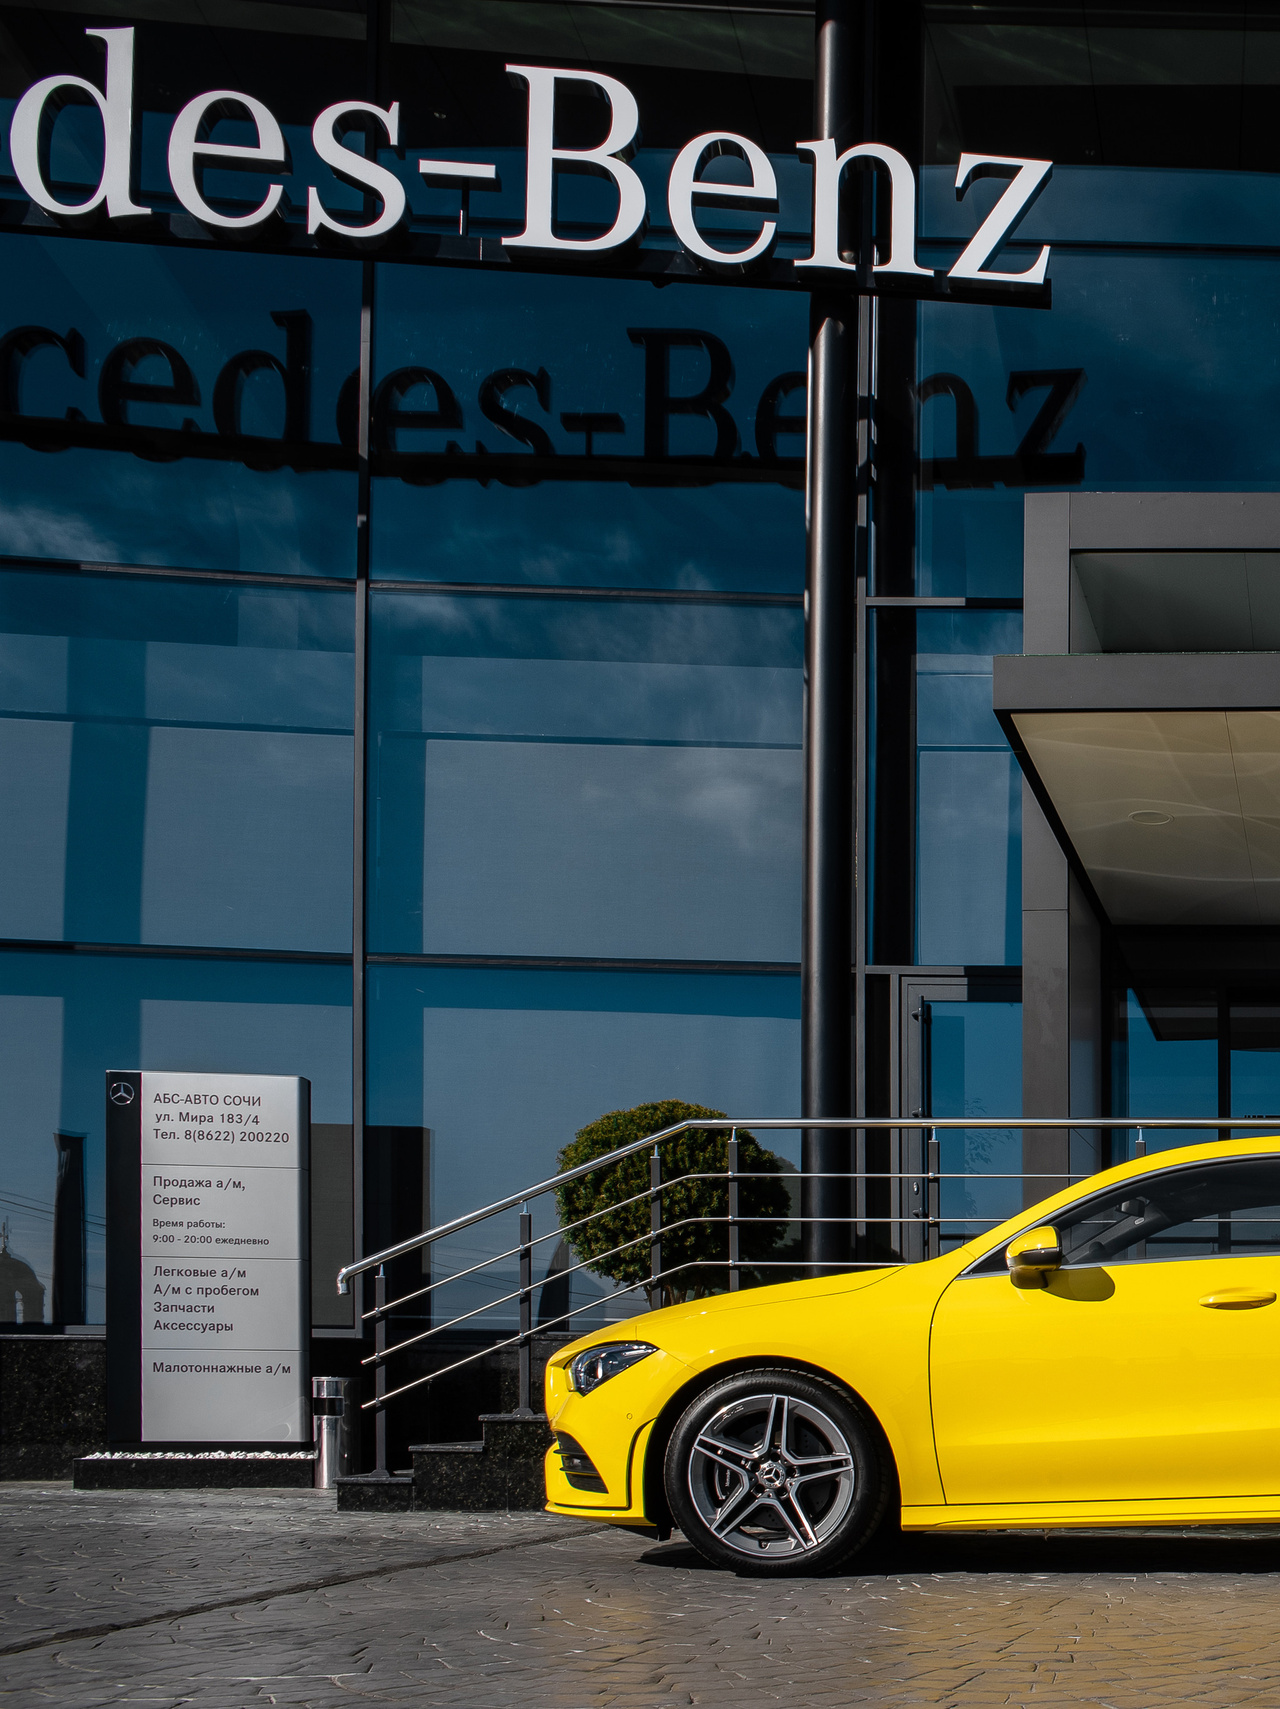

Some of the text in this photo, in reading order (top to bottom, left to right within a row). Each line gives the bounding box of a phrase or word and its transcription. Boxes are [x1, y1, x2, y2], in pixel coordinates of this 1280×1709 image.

[153, 1093, 261, 1107] АБС-АВТО СОЧИ
[154, 1112, 261, 1127] ул. Мира 183/4
[152, 1129, 290, 1145] Тел. 8(8622) 200220
[153, 1176, 246, 1192] Продажа а/м,
[152, 1194, 201, 1208] Сервис
[152, 1219, 226, 1230] Время работы:
[152, 1234, 175, 1244] 9:00
[183, 1234, 213, 1244] 20:00
[214, 1237, 270, 1246] ежедневно
[153, 1266, 247, 1281] Легковые а/м
[153, 1284, 260, 1298] А/м с пробегом
[153, 1302, 215, 1314] Запчасти
[153, 1320, 234, 1334] Аксессуары
[152, 1362, 291, 1377] Малотоннажные а/м
